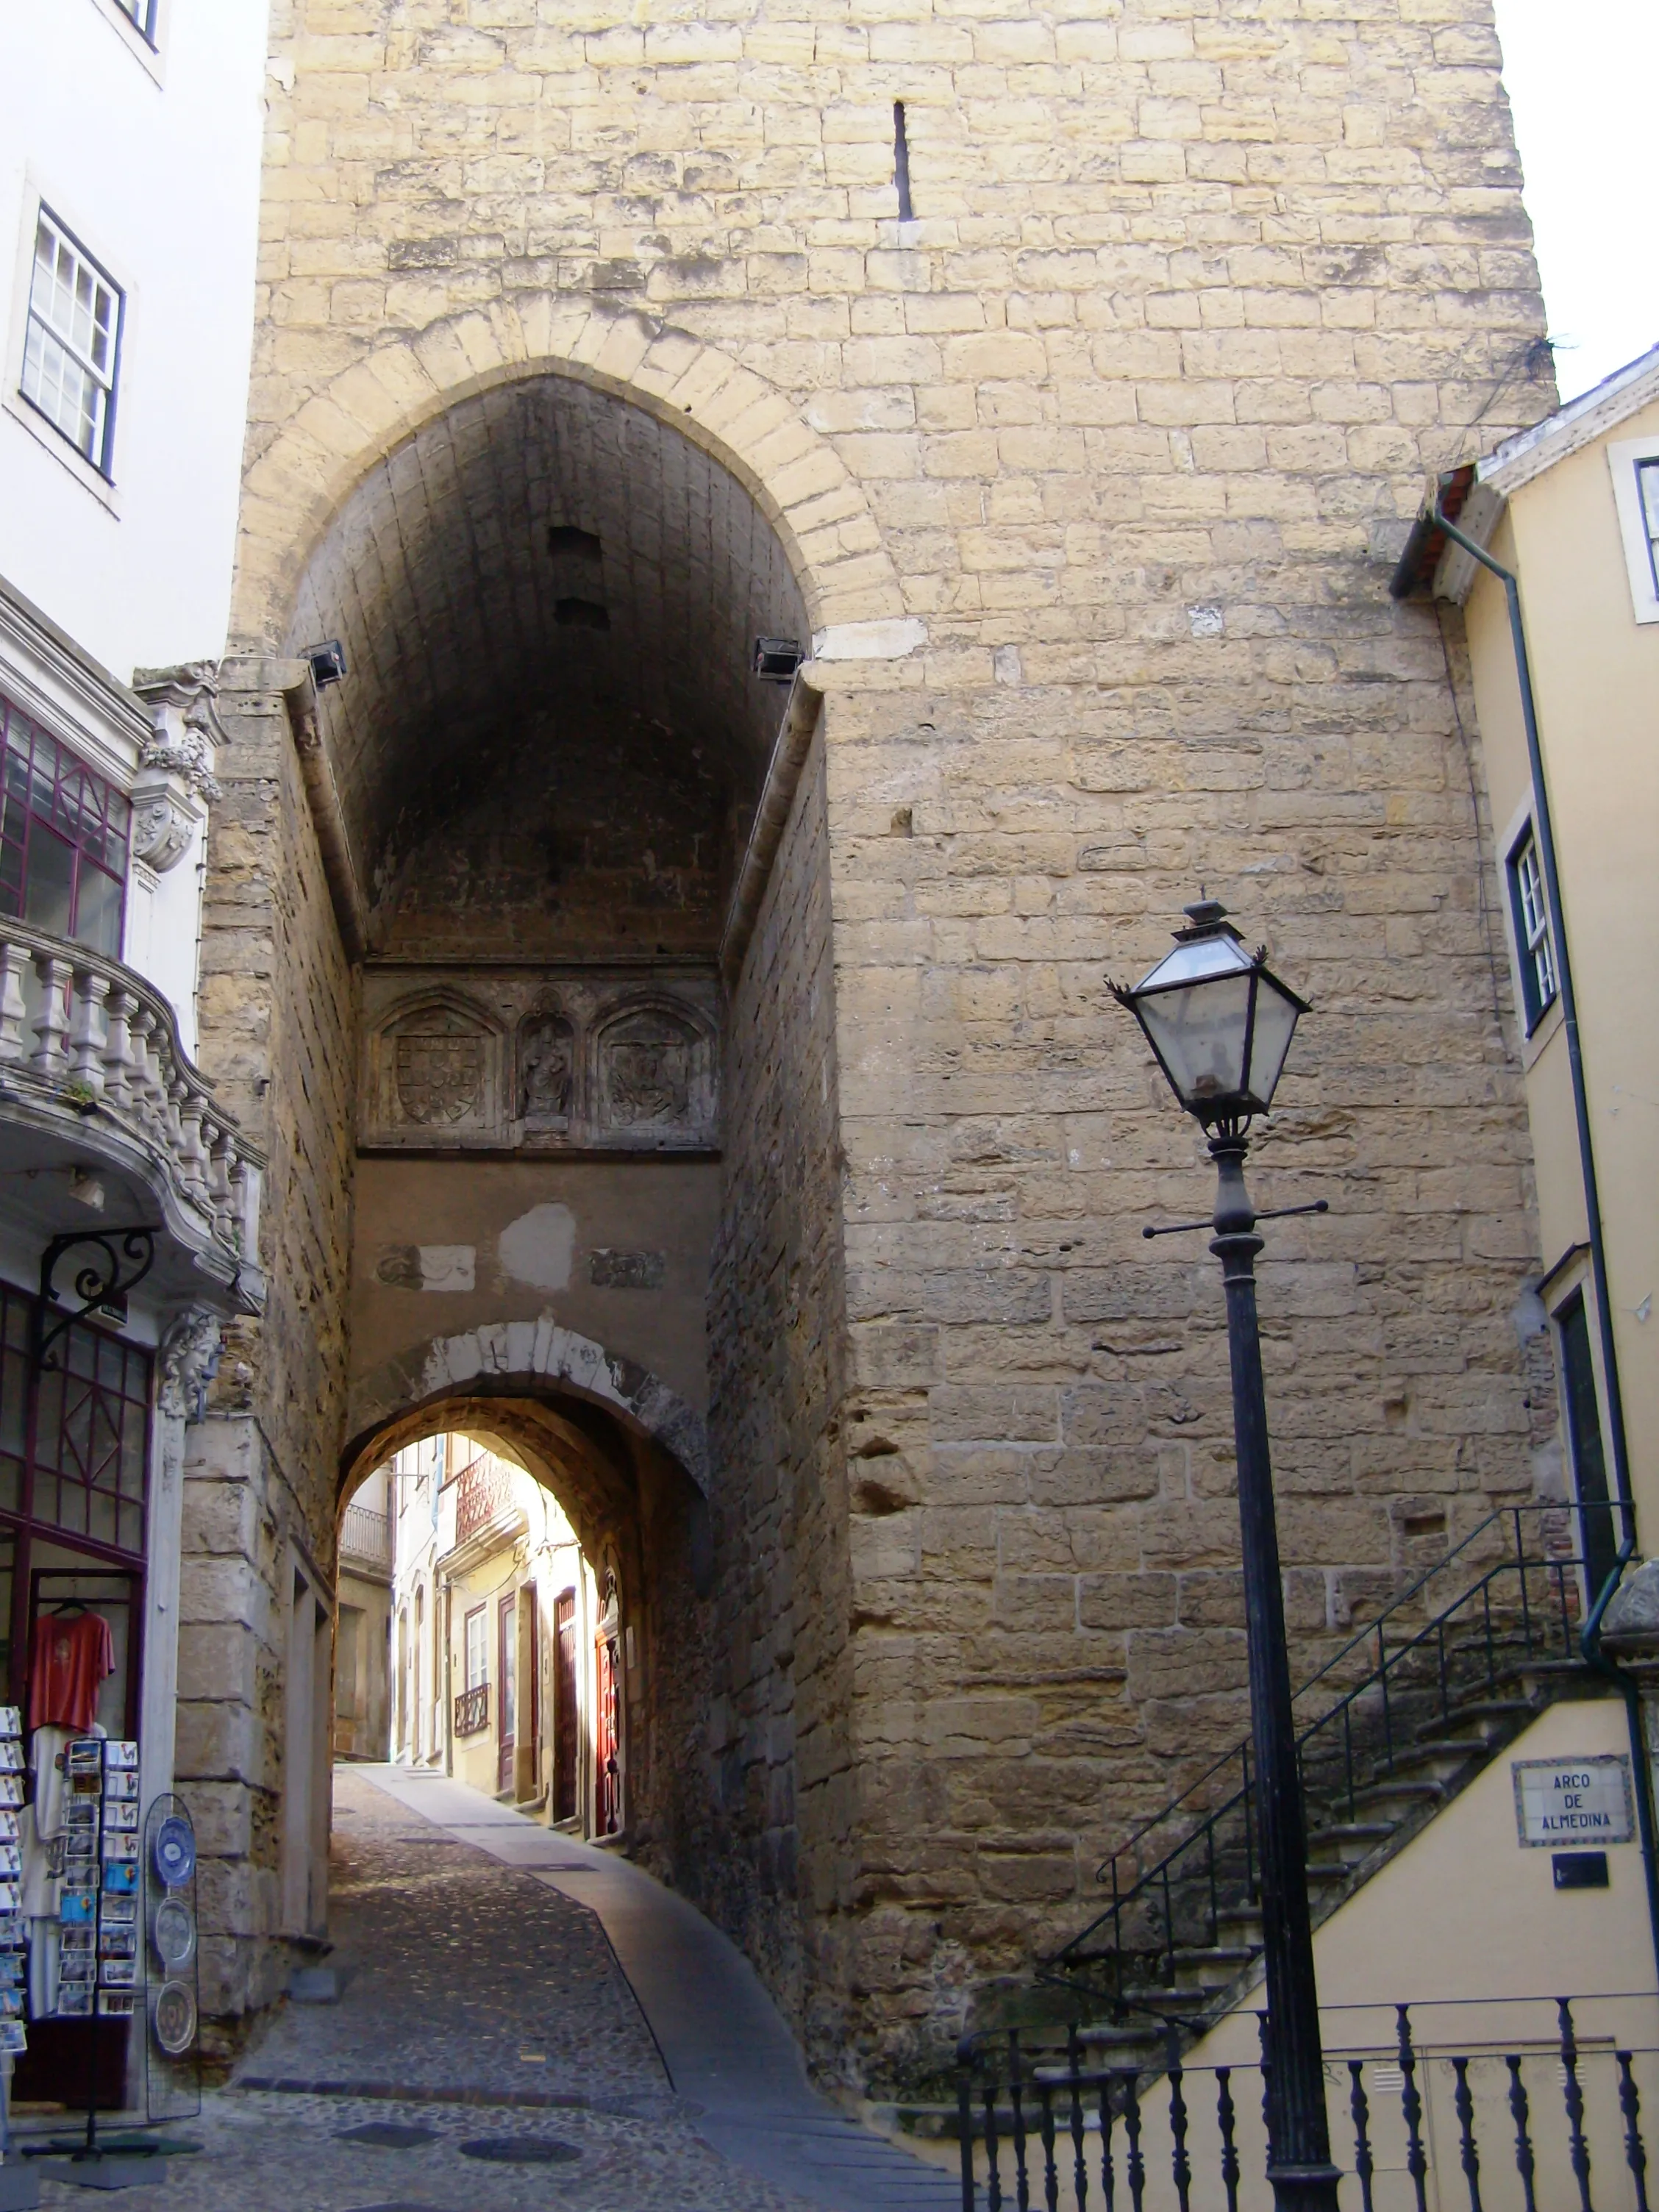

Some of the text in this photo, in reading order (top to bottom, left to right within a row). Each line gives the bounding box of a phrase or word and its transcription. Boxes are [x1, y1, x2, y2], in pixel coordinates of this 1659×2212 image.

[1554, 1774, 1590, 1789] ARCO
[1564, 1794, 1583, 1809] DE
[1542, 1813, 1610, 1830] ALMEDINA
